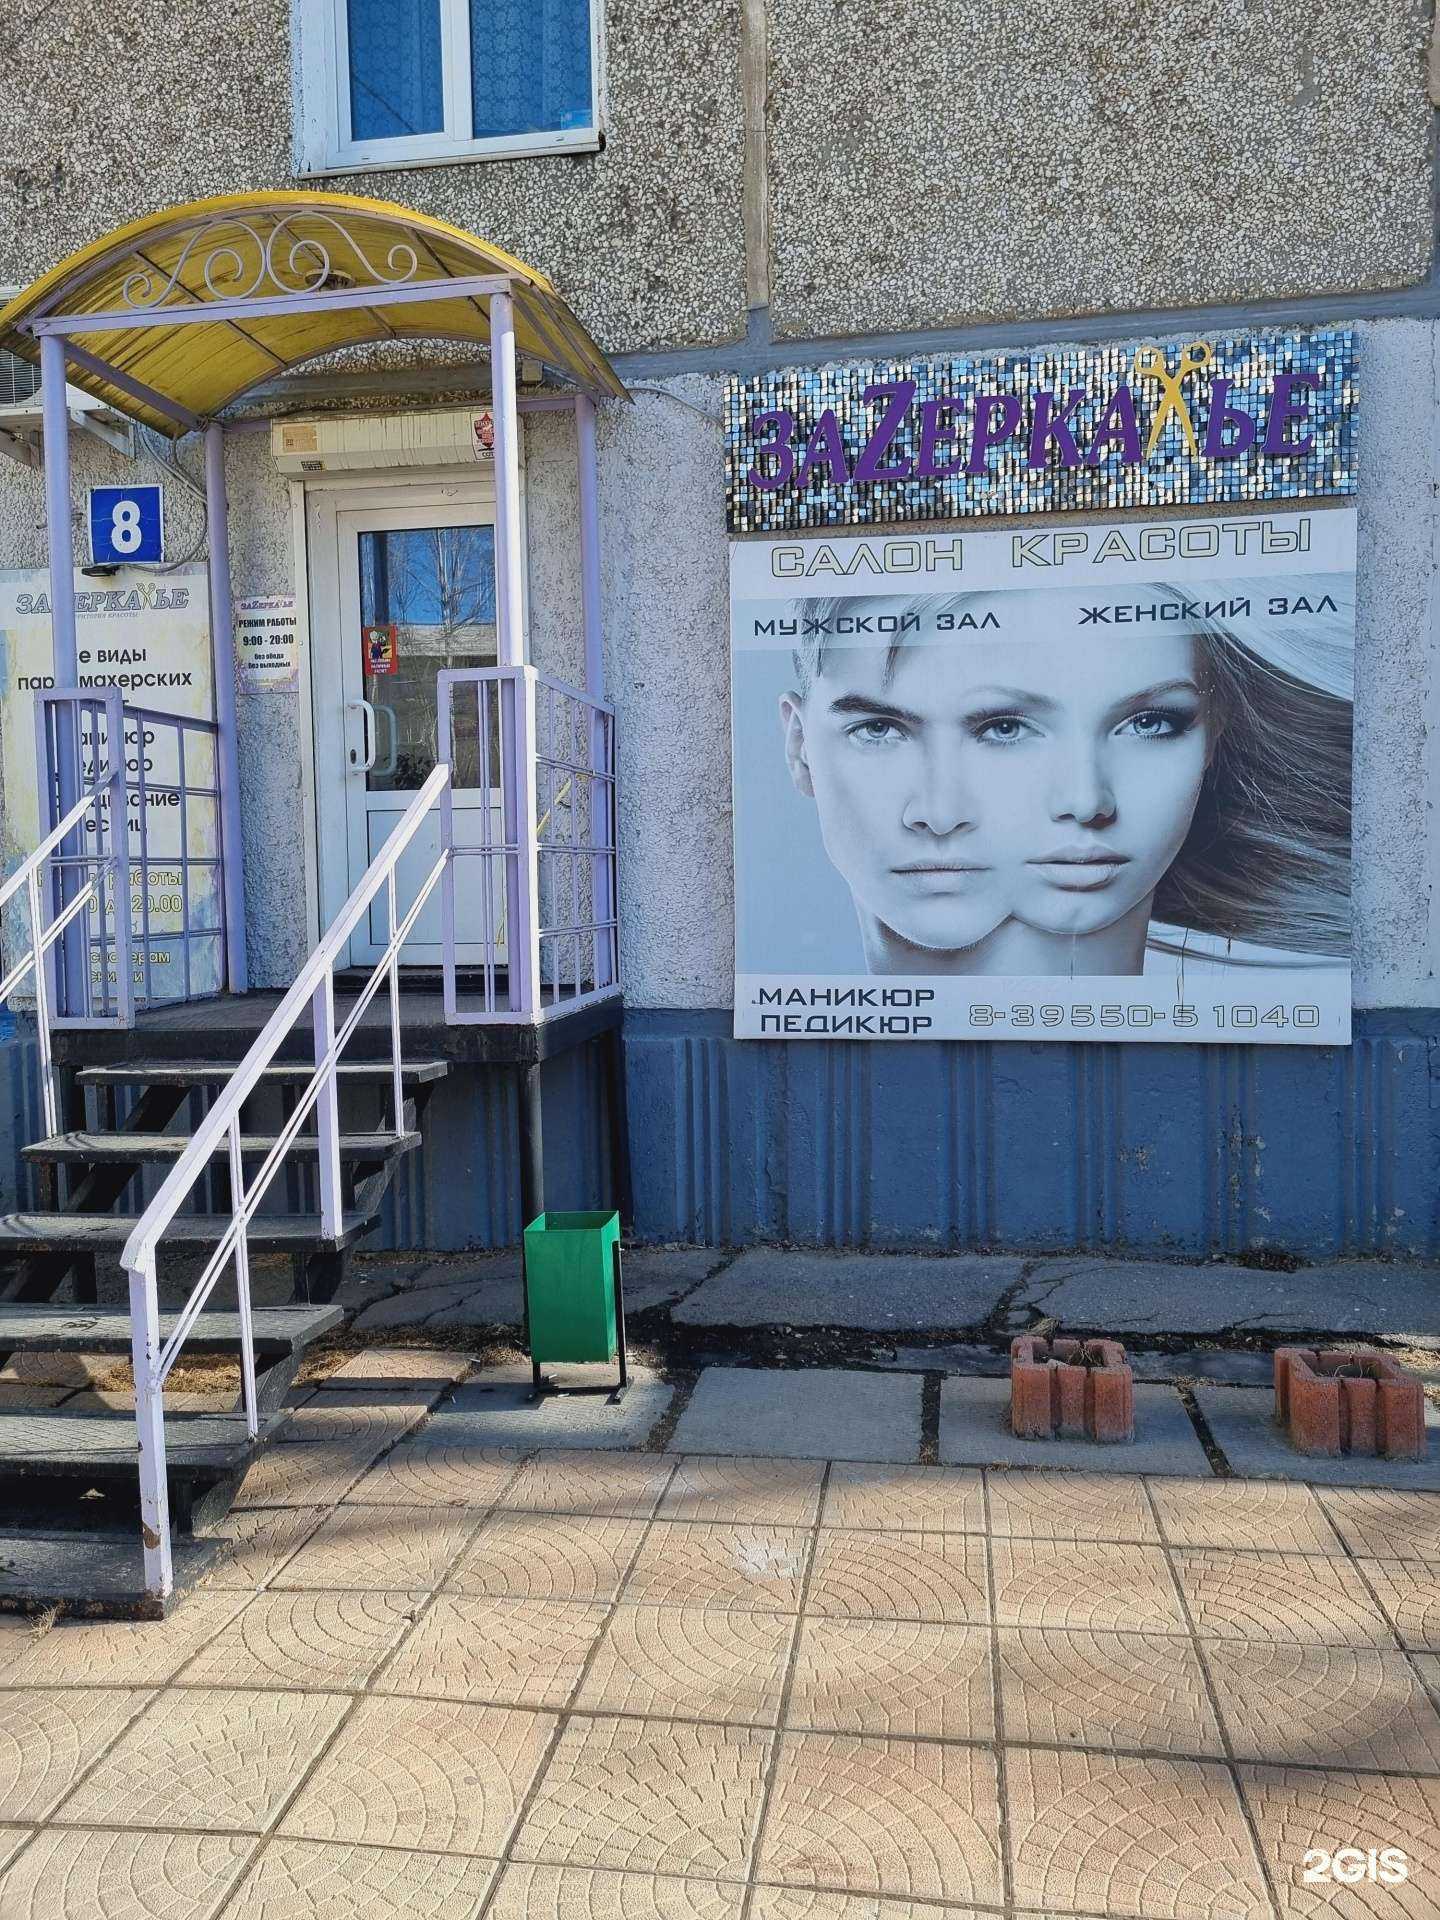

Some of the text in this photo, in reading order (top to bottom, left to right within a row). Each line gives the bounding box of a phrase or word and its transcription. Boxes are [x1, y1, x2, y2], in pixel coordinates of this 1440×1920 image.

[111, 500, 142, 554] 8
[771, 518, 1311, 578] САЛОН КРАСОТЫ
[1078, 595, 1338, 625] ЖЕНСКИЙ ЗАЛ
[239, 617, 297, 628] РЕЖИМ РАБОТЫ
[754, 612, 1001, 636] МУЖСКОЙ ЗАЛ
[243, 636, 263, 646] 9:00
[269, 634, 294, 645] 20:00
[98, 649, 147, 664] виды
[759, 987, 935, 1007] МАНИКЮР
[761, 1014, 932, 1034] ПЕДИКЮР
